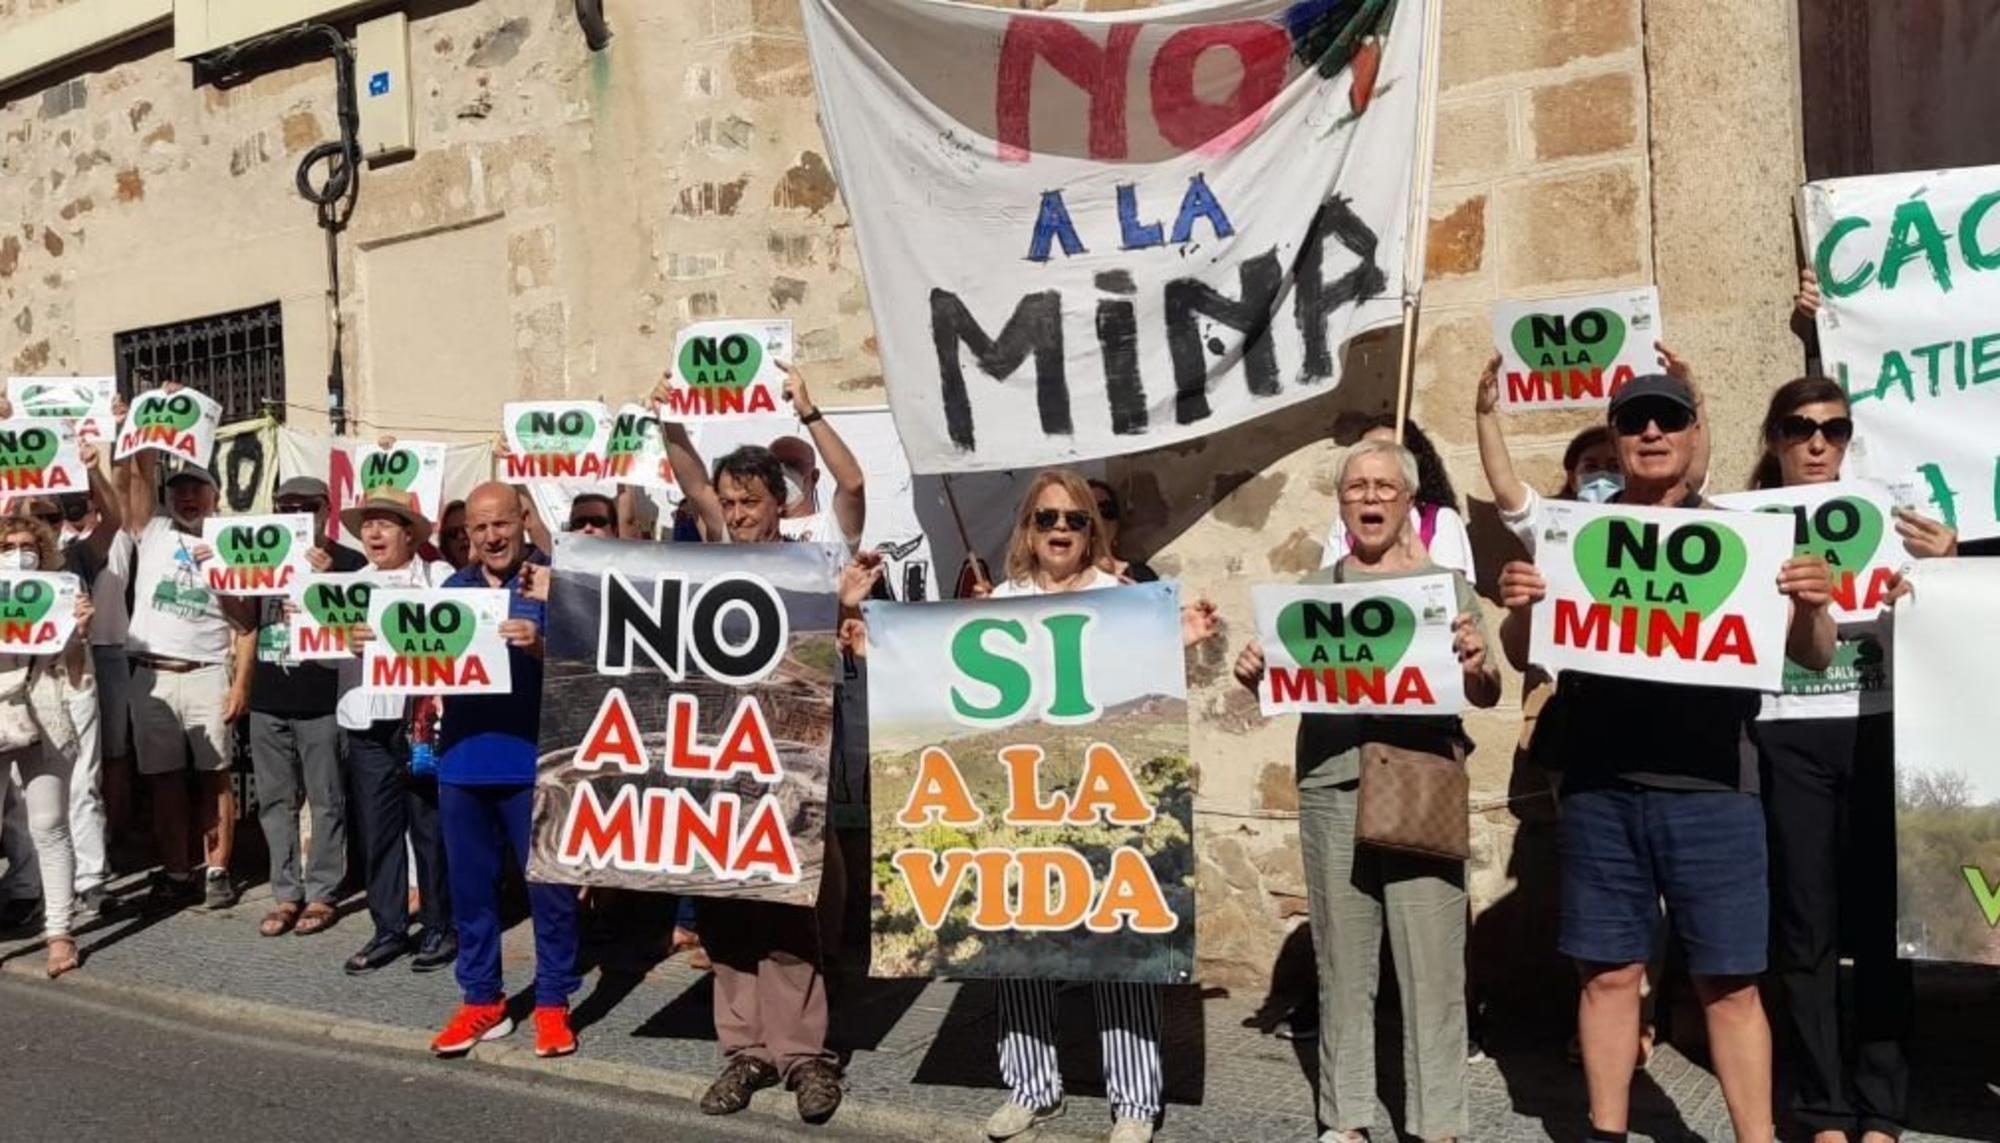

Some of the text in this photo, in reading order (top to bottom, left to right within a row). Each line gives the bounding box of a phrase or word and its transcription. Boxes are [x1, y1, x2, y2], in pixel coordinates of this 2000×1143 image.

[995, 15, 1292, 163] NO
[1025, 172, 1235, 262] A LA
[1531, 310, 1608, 348] NO
[692, 335, 749, 366] NO
[1540, 349, 1592, 366] A LA
[697, 369, 736, 384] A LA
[143, 395, 191, 415] NO
[669, 384, 776, 415] MINA
[143, 415, 174, 425] A LA
[531, 411, 584, 436] NO
[122, 425, 196, 457] MINA
[15, 454, 36, 465] LA
[369, 450, 409, 476] NO
[507, 452, 600, 478] MINA
[0, 465, 71, 491] INA
[231, 525, 280, 550] NO
[1605, 520, 1722, 576] NO
[235, 552, 269, 564] A LA
[318, 583, 371, 609] NO
[1609, 577, 1689, 604] A LA
[1830, 567, 1895, 611] NA
[4, 606, 27, 618] LA
[327, 612, 366, 624] A LA
[397, 602, 461, 634] NO
[1303, 599, 1395, 639] NO
[4, 620, 58, 645] NA
[299, 624, 352, 652] MI
[600, 573, 786, 682] NO
[1554, 598, 1758, 665] MINA
[404, 638, 446, 652] A LA
[1311, 644, 1374, 662] A LA
[372, 655, 491, 686] MINA
[951, 612, 1100, 723] SI
[1270, 666, 1436, 705] MINA
[577, 689, 782, 780] A LA
[898, 744, 1156, 827] A LA
[561, 784, 801, 880] MINA
[894, 848, 1179, 931] VIDA
